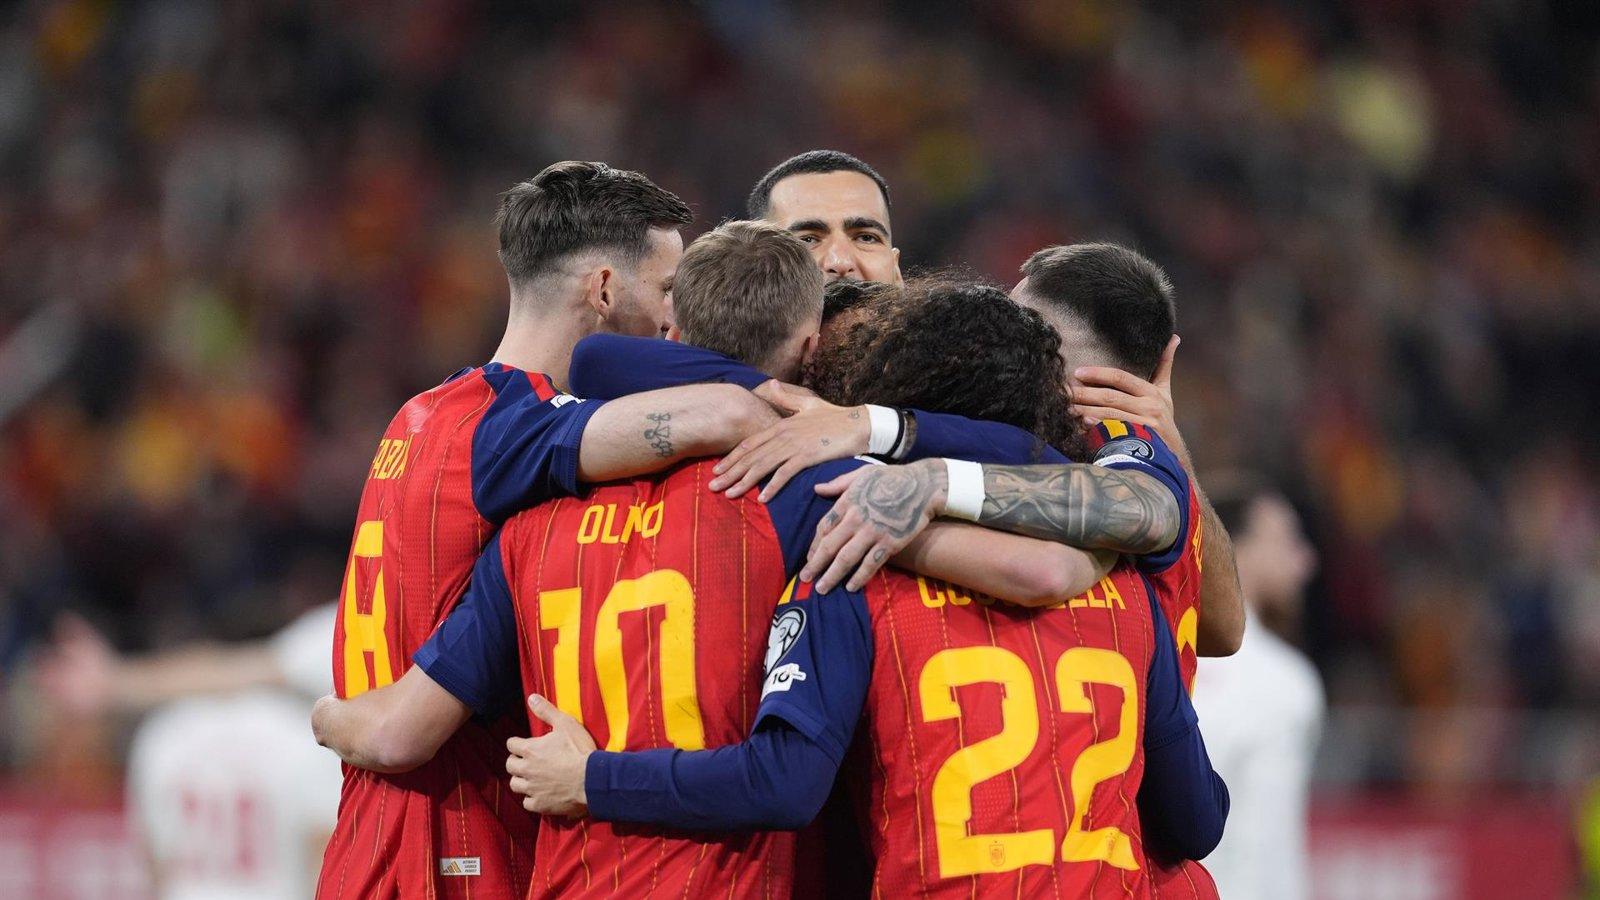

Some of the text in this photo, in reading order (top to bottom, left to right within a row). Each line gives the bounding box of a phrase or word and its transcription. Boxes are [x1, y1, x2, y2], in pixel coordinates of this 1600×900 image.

[343, 520, 394, 699] 8
[539, 568, 706, 753] 10
[918, 646, 1141, 879] 22
